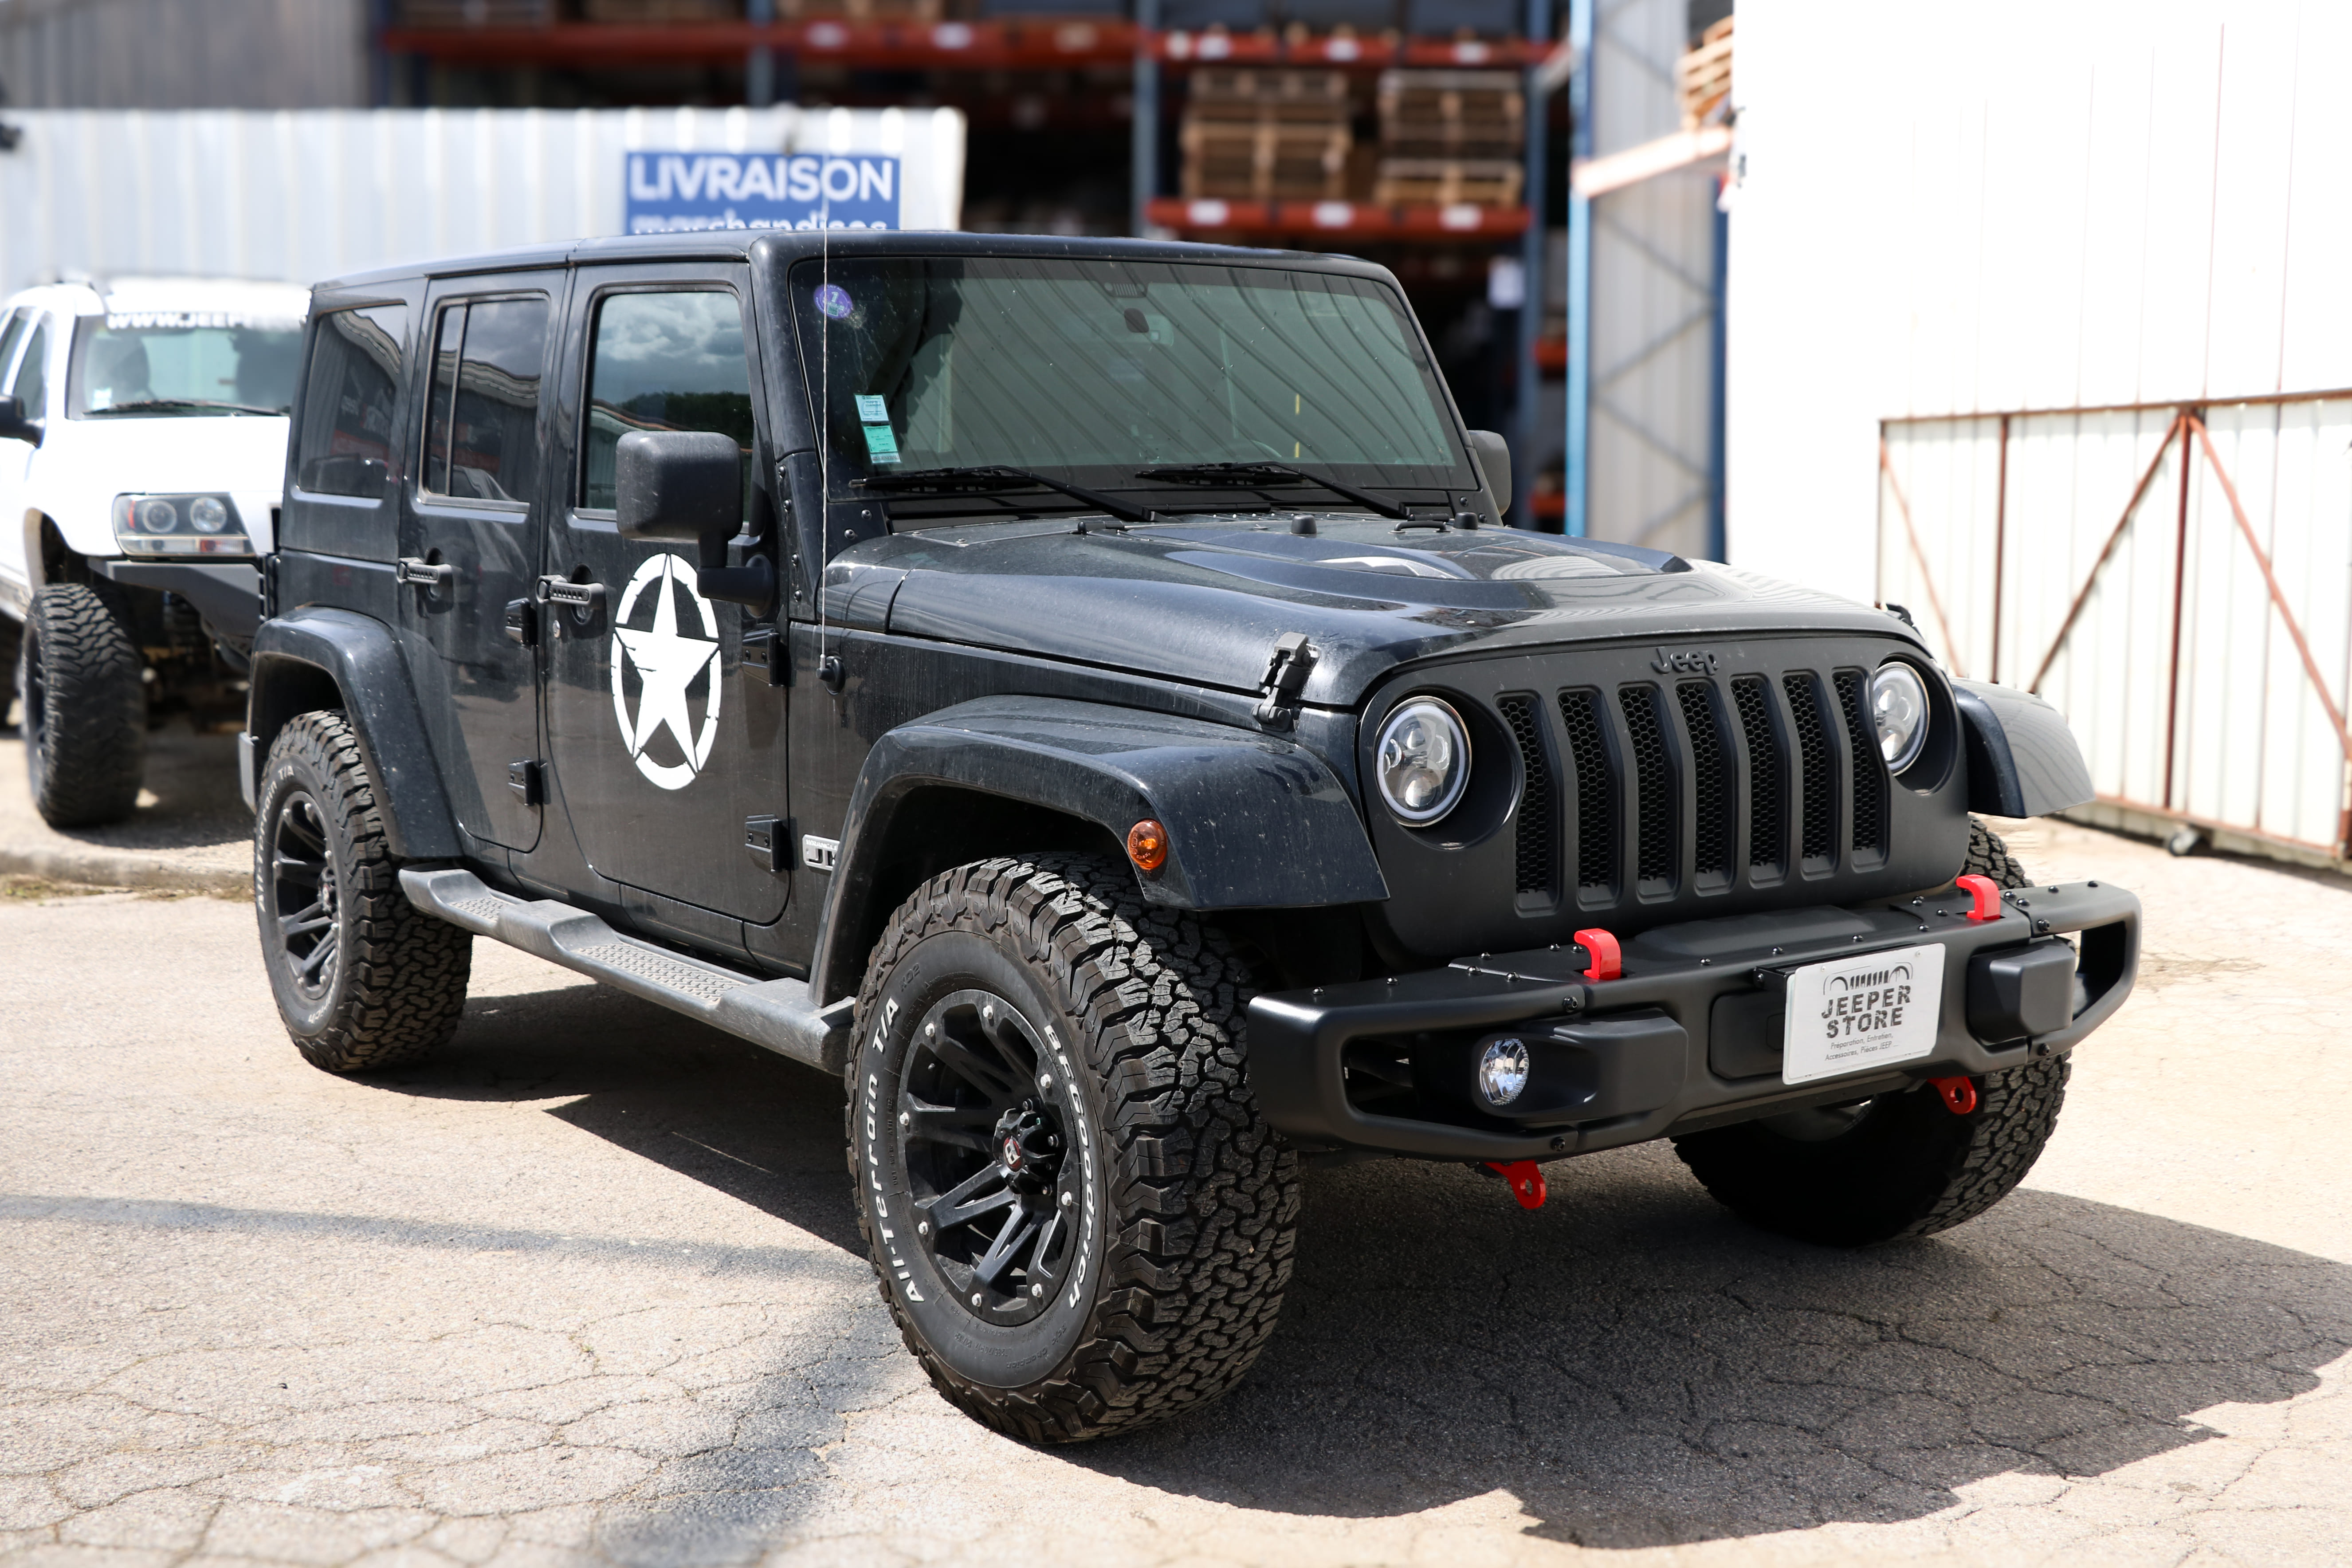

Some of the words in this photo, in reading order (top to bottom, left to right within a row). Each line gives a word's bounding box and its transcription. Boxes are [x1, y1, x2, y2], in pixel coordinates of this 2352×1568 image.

[630, 157, 893, 201] LIVRAISON
[1650, 646, 1721, 676] Jeep
[805, 839, 838, 851] WRANGLE
[1821, 985, 1912, 1019] JEEPER
[872, 998, 899, 1053] T/A
[1826, 1006, 1904, 1039] STORE
[1824, 1049, 1859, 1061] Accessoires,
[1879, 1041, 1893, 1050] JEEP
[1044, 1024, 1095, 1309] BFGoodrich
[867, 1072, 925, 1303] All-Terrain
